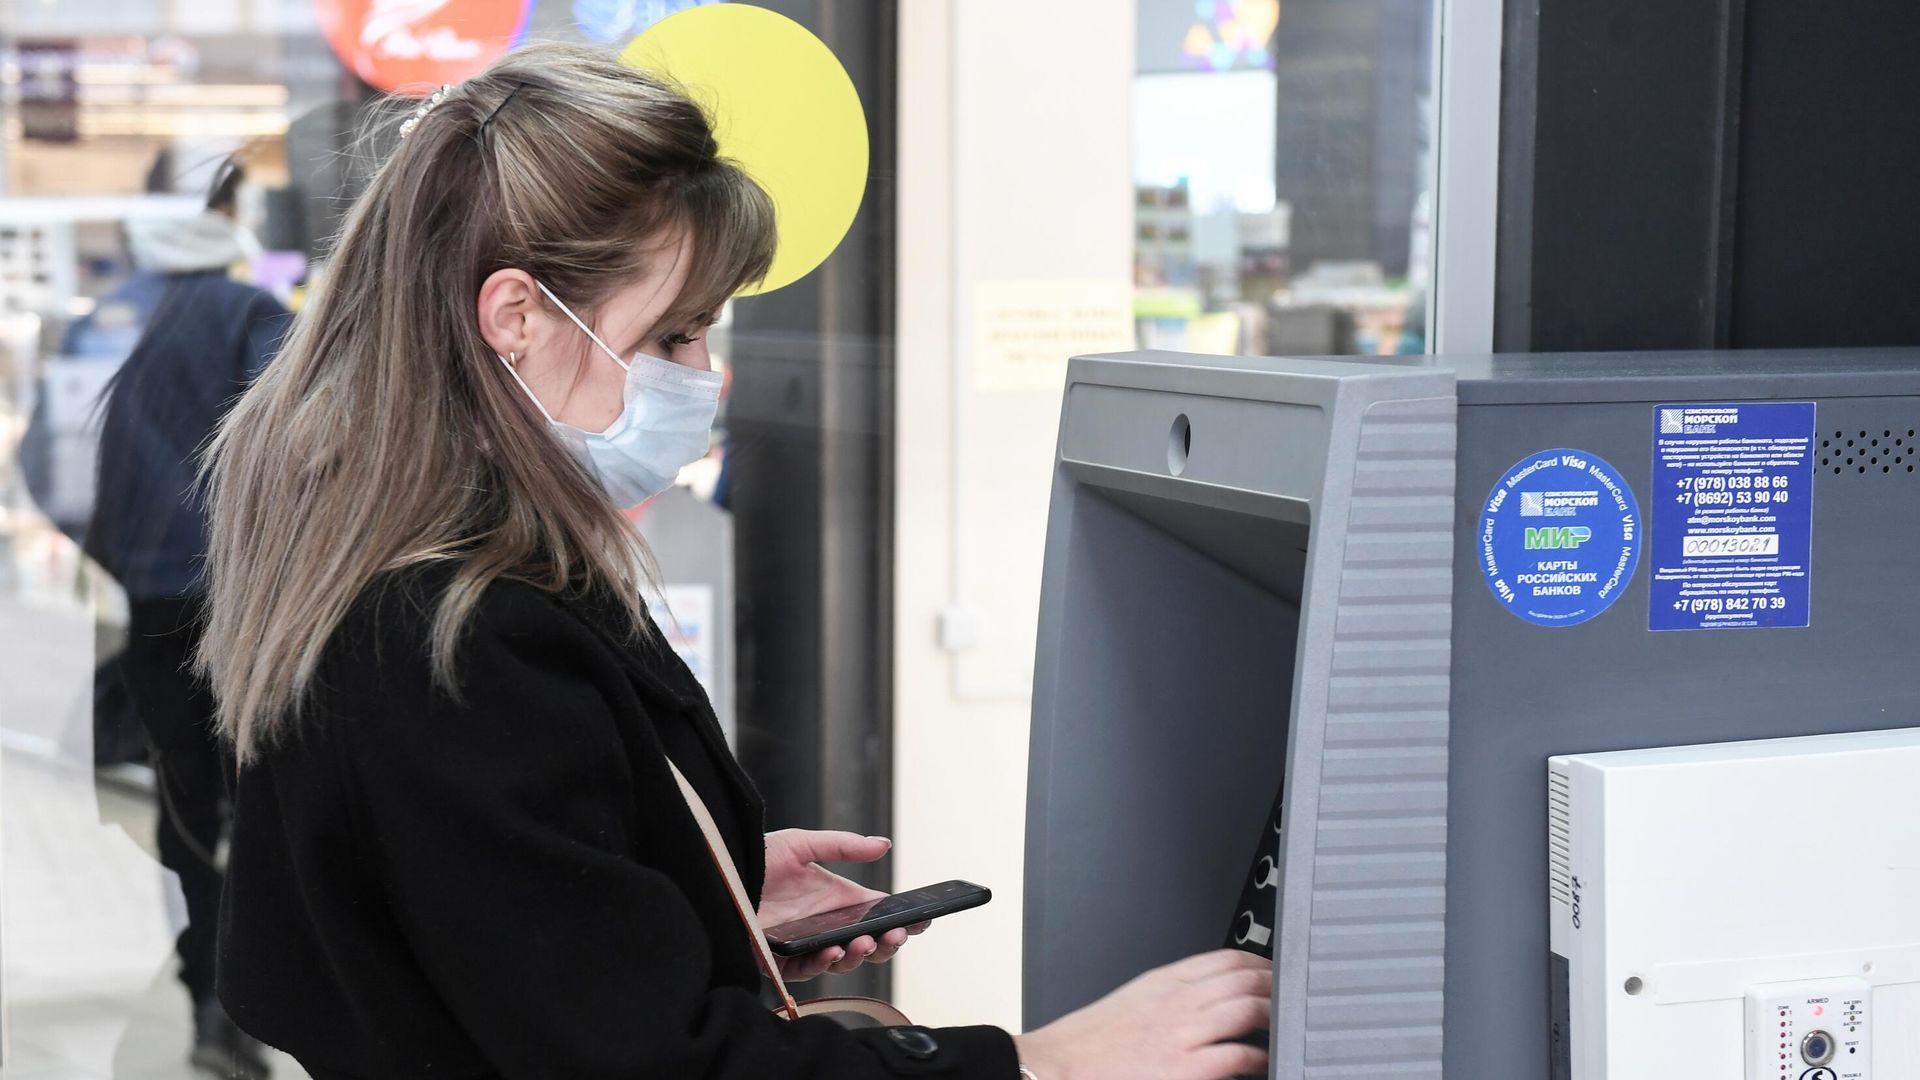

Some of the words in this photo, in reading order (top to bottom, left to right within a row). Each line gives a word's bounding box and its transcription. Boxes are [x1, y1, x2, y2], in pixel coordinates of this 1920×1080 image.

[1684, 414, 1738, 424] МОРСКОЙ
[1562, 455, 1587, 470] Visa
[1506, 457, 1558, 488] MasterCard
[1588, 465, 1628, 512] MasterCard
[1676, 477, 1693, 490] +7
[1694, 477, 1726, 492] (978)
[1728, 476, 1751, 489] 038
[1754, 476, 1770, 488] 88
[1772, 475, 1788, 488] 66
[1487, 488, 1508, 513] Visa
[1544, 497, 1599, 507] МОРСКОЙ
[1676, 492, 1692, 504] +7
[1694, 491, 1733, 507] (8692)
[1736, 491, 1752, 503] 53
[1754, 491, 1770, 503] 90
[1772, 490, 1788, 503] 40
[1622, 514, 1635, 541] Visa
[1688, 526, 1776, 534] www.morskoybank.com
[1524, 526, 1592, 550] МИР
[1482, 518, 1499, 577] MasterCard
[1537, 561, 1578, 571] КАРТЫ
[1598, 546, 1632, 599] MasterCard
[1517, 572, 1598, 584] РОССИЙСКИХ
[1494, 578, 1515, 603] Visa
[1532, 585, 1582, 596] БАНКОВ
[1673, 599, 1690, 612] +7
[1691, 598, 1723, 613] (978)
[1726, 598, 1749, 610] 842
[1752, 597, 1767, 609] 70
[1770, 597, 1786, 609] 39
